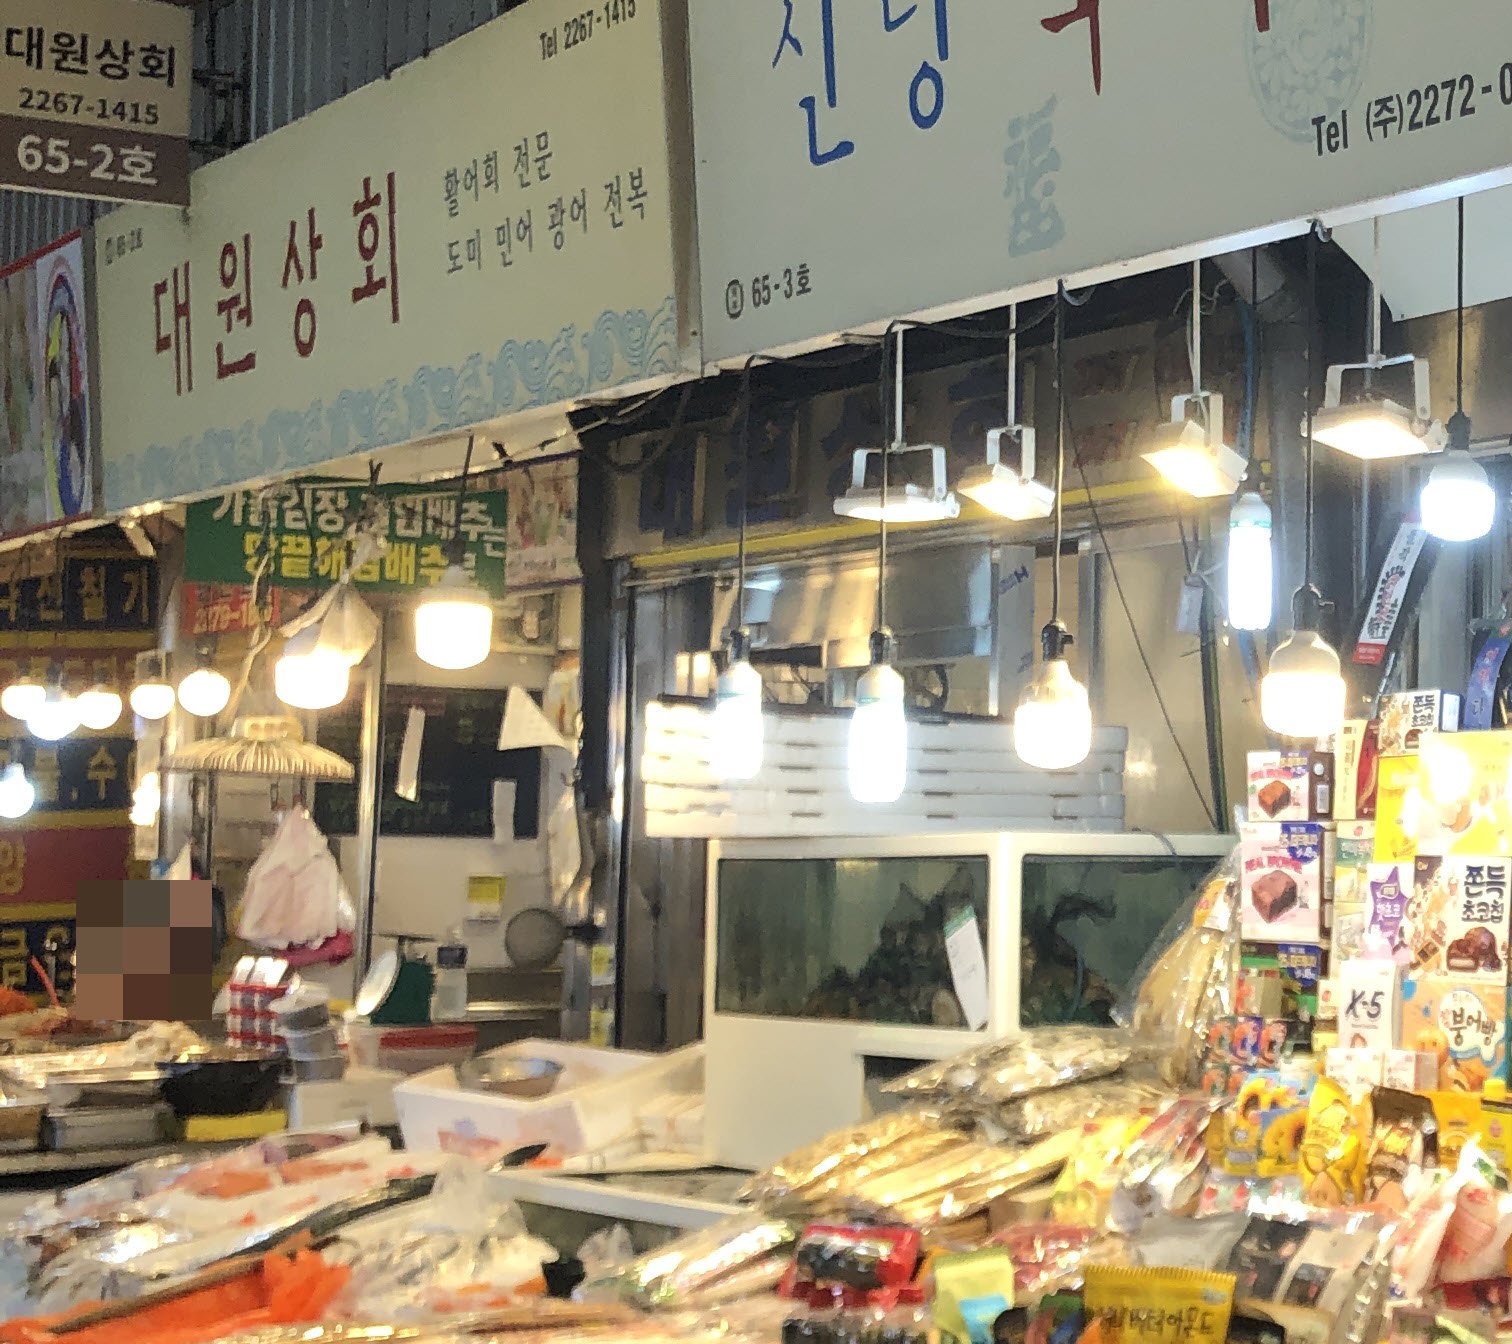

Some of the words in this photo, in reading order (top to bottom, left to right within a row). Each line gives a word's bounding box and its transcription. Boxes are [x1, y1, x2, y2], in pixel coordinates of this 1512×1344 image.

[3, 26, 177, 89] 대원상회
[539, 32, 557, 60] Tel
[17, 87, 160, 128] 2267-1415
[1311, 111, 1349, 157] Tel
[16, 134, 159, 189] 65-2호
[513, 130, 553, 189] 전문
[447, 228, 483, 274] 도미
[495, 208, 533, 268] 민어
[548, 187, 589, 251] 광어
[604, 167, 648, 229] 전복
[152, 170, 400, 396] 대원상회
[1463, 865, 1507, 899] 쫀득
[1342, 987, 1385, 1020] X-5
